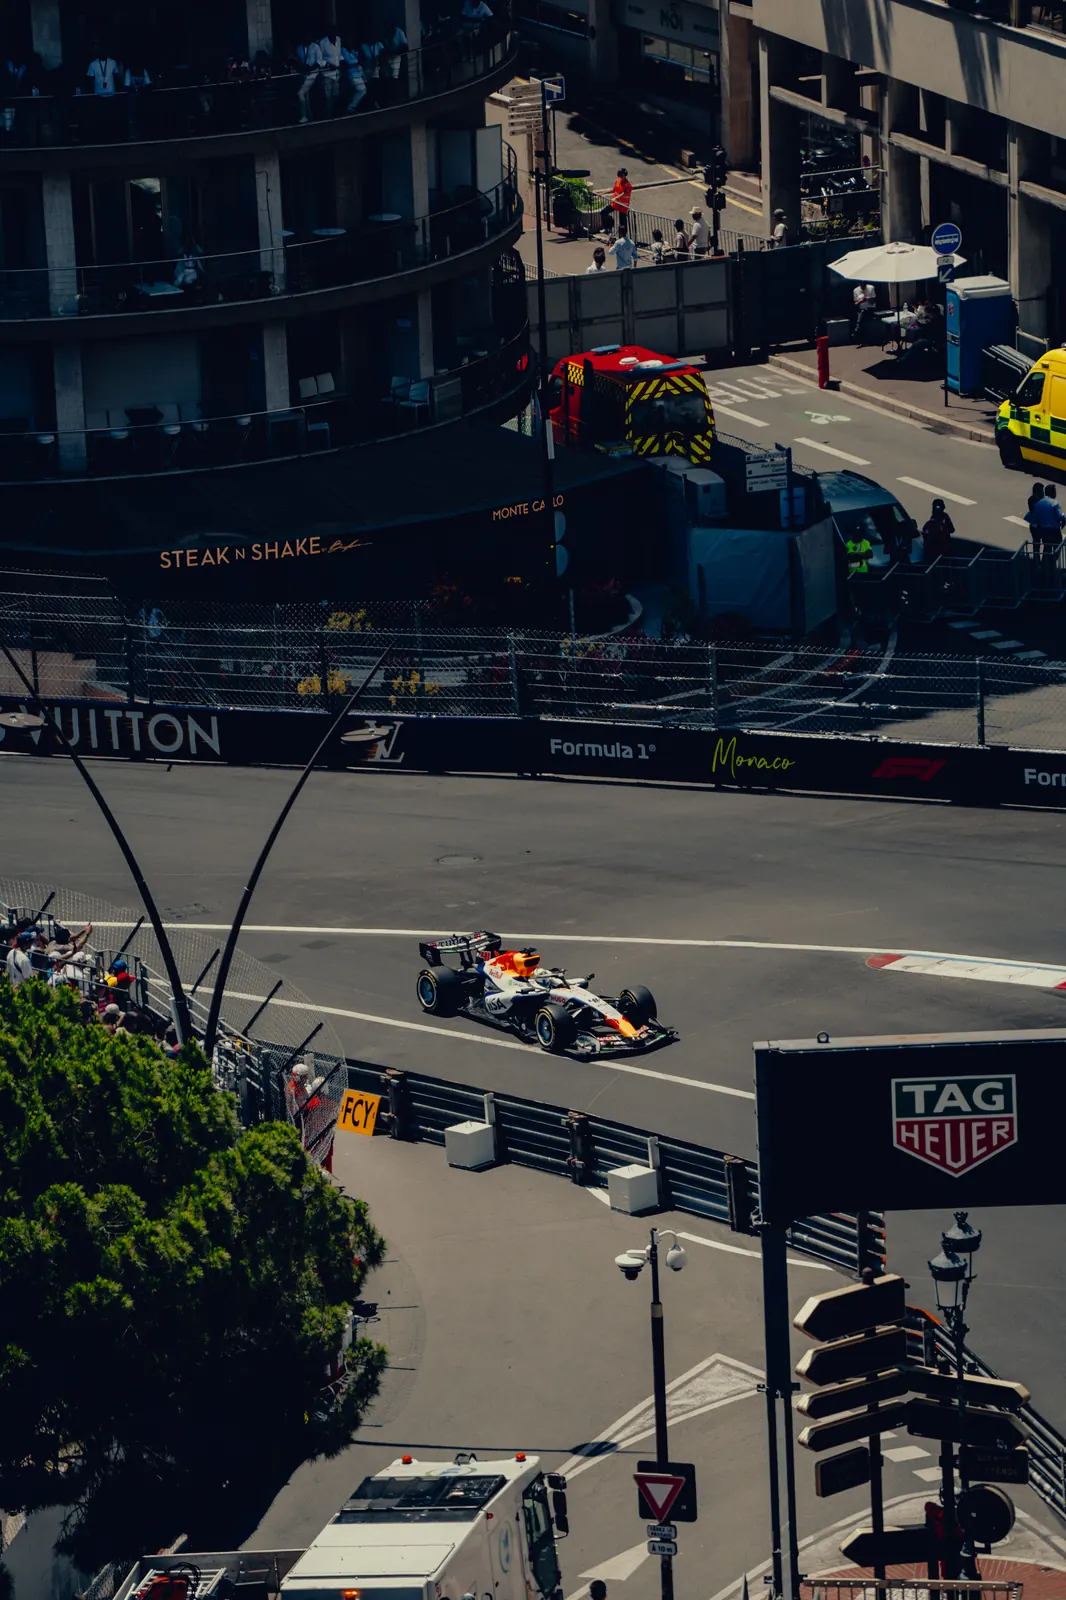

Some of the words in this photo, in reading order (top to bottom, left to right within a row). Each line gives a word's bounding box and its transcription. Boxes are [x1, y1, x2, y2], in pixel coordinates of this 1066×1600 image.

[492, 502, 529, 521] MONTE
[531, 494, 564, 512] CALO
[159, 546, 230, 569] STEAK
[235, 548, 245, 561] N
[251, 536, 321, 561] SHAKE
[549, 738, 634, 759] Formula
[711, 737, 796, 779] Monaco
[1023, 768, 1066, 787] For
[342, 1096, 375, 1129] FCY
[902, 1081, 1005, 1114] TAG
[900, 1120, 1010, 1169] HEUER
[658, 1545, 666, 1553] 10
